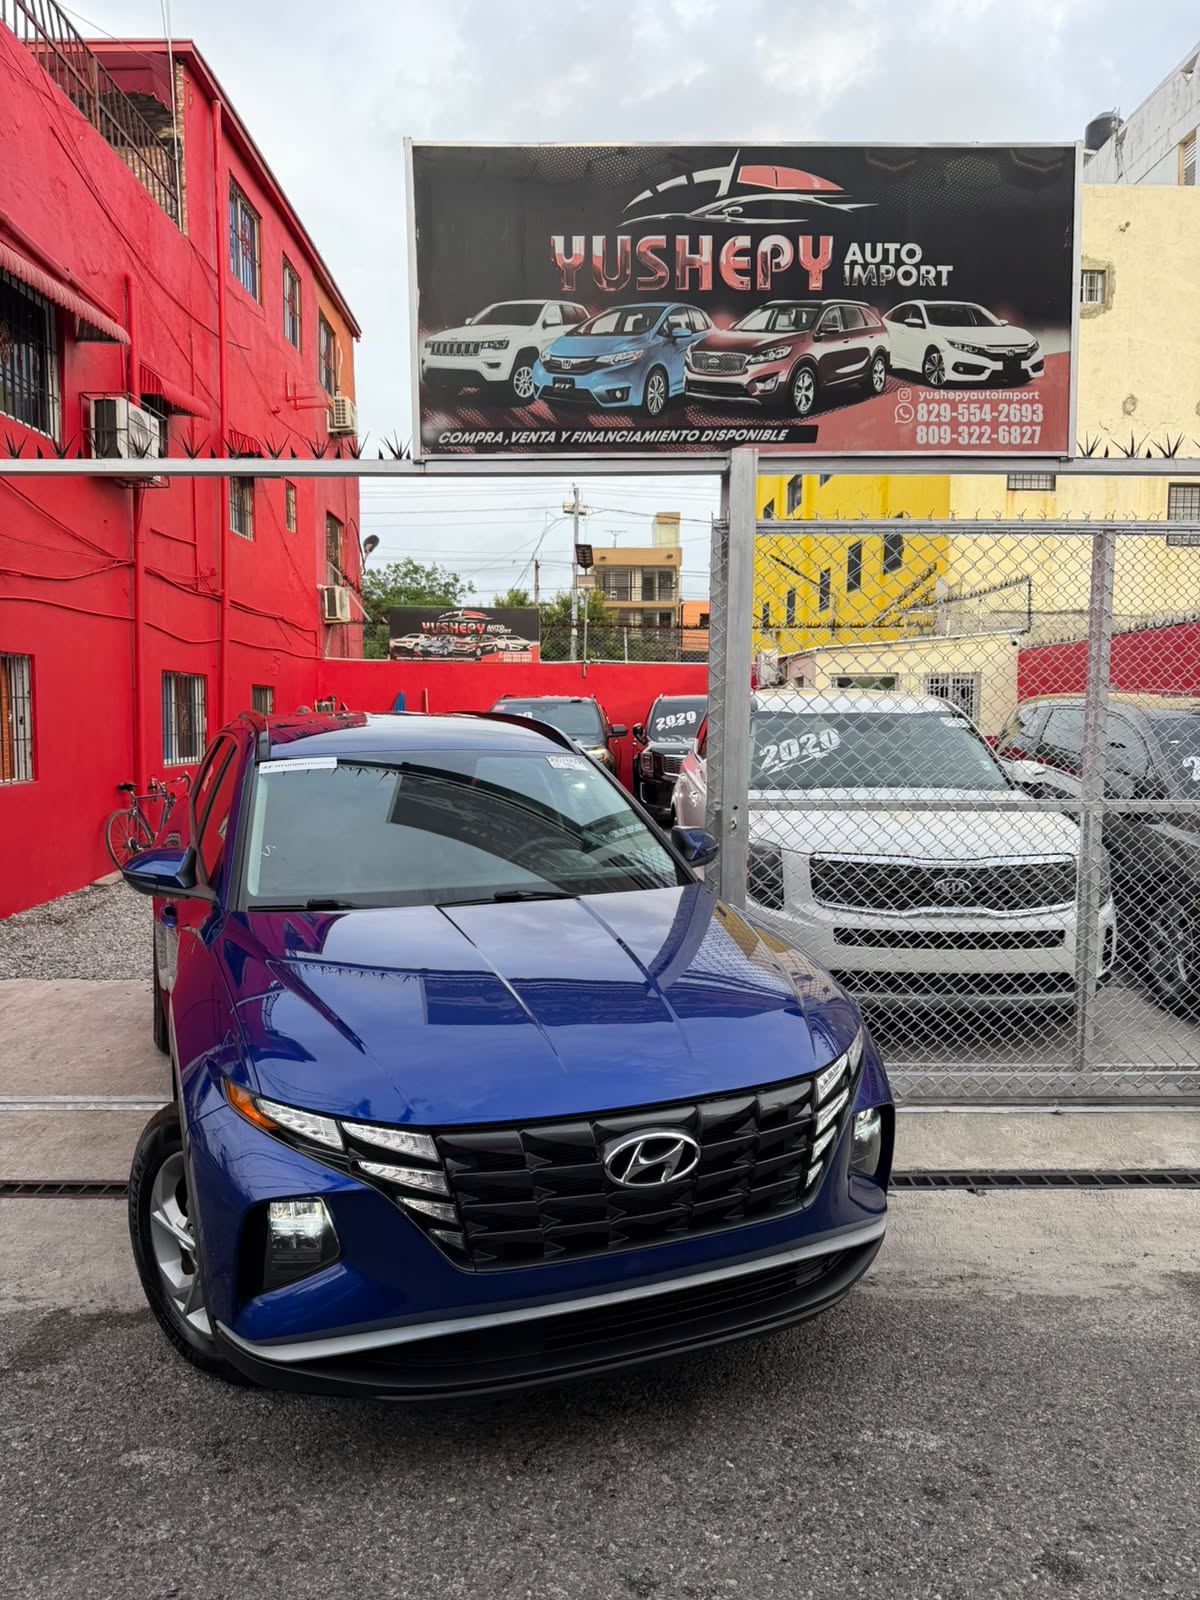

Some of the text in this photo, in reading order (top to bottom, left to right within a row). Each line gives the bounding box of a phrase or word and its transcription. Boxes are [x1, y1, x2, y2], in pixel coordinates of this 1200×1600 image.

[550, 235, 834, 291] YUSHEPY
[844, 242, 923, 264] AUTO
[843, 265, 953, 287] IMPORT
[918, 389, 1040, 402] yushepyautoimport
[916, 403, 1044, 423] 829-554-2693
[559, 431, 571, 443] Y
[570, 428, 700, 443] FINANCIAMIENTO
[700, 428, 789, 442] DISPONIBLE
[916, 425, 1042, 445] 809-322-6827
[421, 621, 486, 635] YUSHEPY
[656, 711, 697, 731] 2020
[759, 728, 841, 770] 2020
